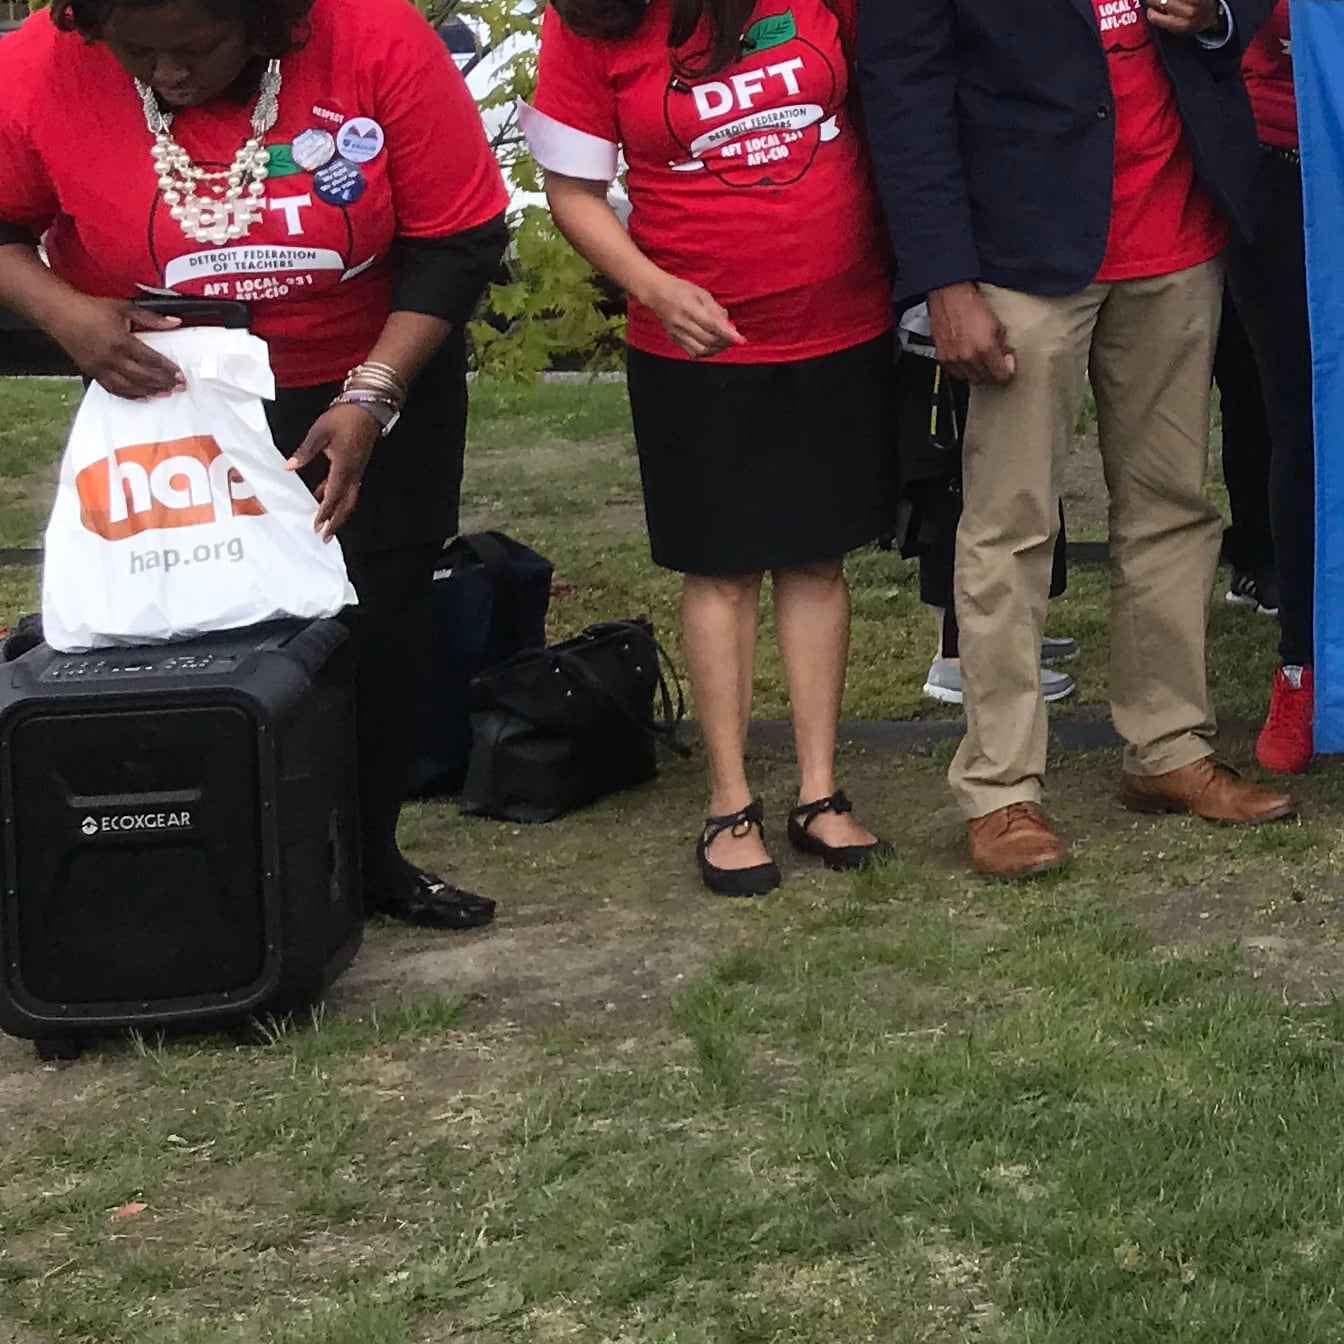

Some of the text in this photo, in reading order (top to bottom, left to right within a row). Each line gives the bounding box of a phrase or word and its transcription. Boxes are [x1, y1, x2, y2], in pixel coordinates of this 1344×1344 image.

[1100, 11, 1138, 31] AFL-CIO
[691, 57, 805, 121] DFT
[708, 122, 750, 143] DETROIT
[751, 107, 807, 130] FEDERATION
[721, 142, 742, 158] AFT
[746, 132, 780, 152] LOCAL
[747, 146, 789, 167] AFL-CIO
[190, 249, 316, 267] DETROIT FEDERATION
[213, 259, 294, 272] OF TEACHERS
[203, 282, 230, 297] AFT
[235, 276, 281, 293] LOCAL
[107, 451, 258, 524] hap
[130, 537, 245, 574] hap.org
[101, 811, 191, 832] ECOXGEAR
